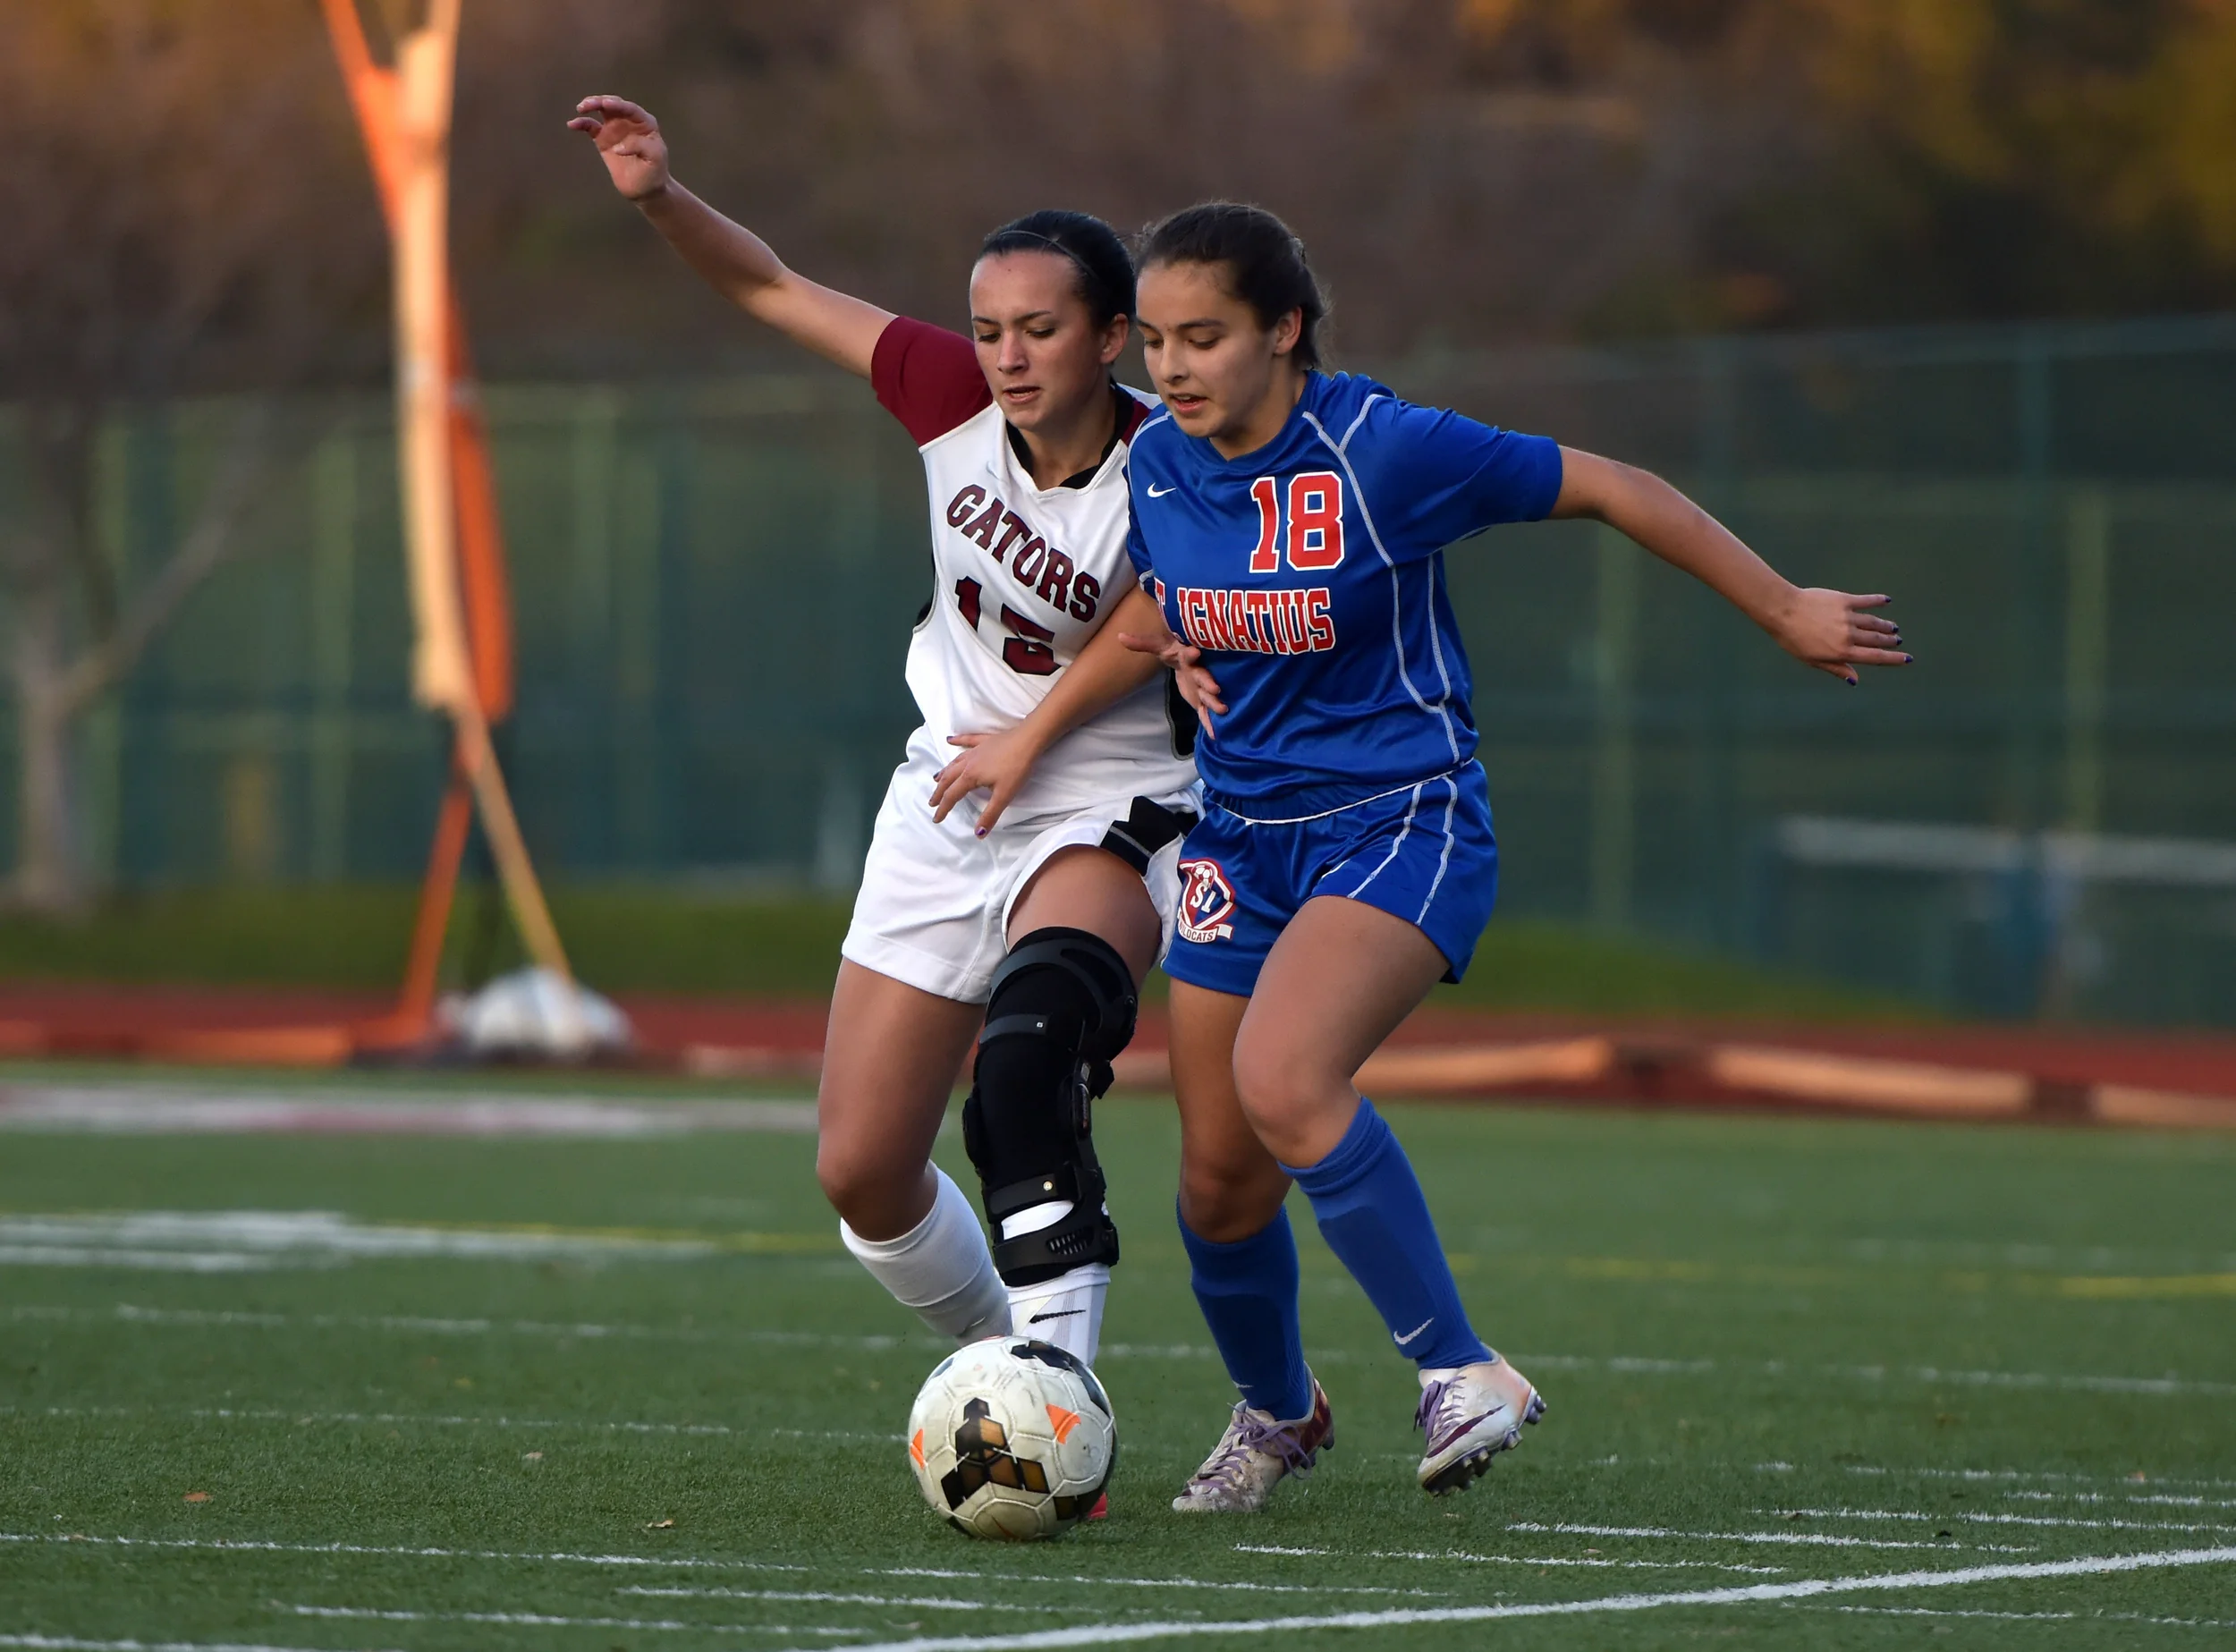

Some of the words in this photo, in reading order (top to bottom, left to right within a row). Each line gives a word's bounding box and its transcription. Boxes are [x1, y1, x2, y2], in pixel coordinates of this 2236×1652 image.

[946, 484, 1100, 623] GATORS
[1249, 471, 1344, 573] 18
[955, 576, 1062, 676] 15
[1177, 587, 1336, 656] IGNATIUS
